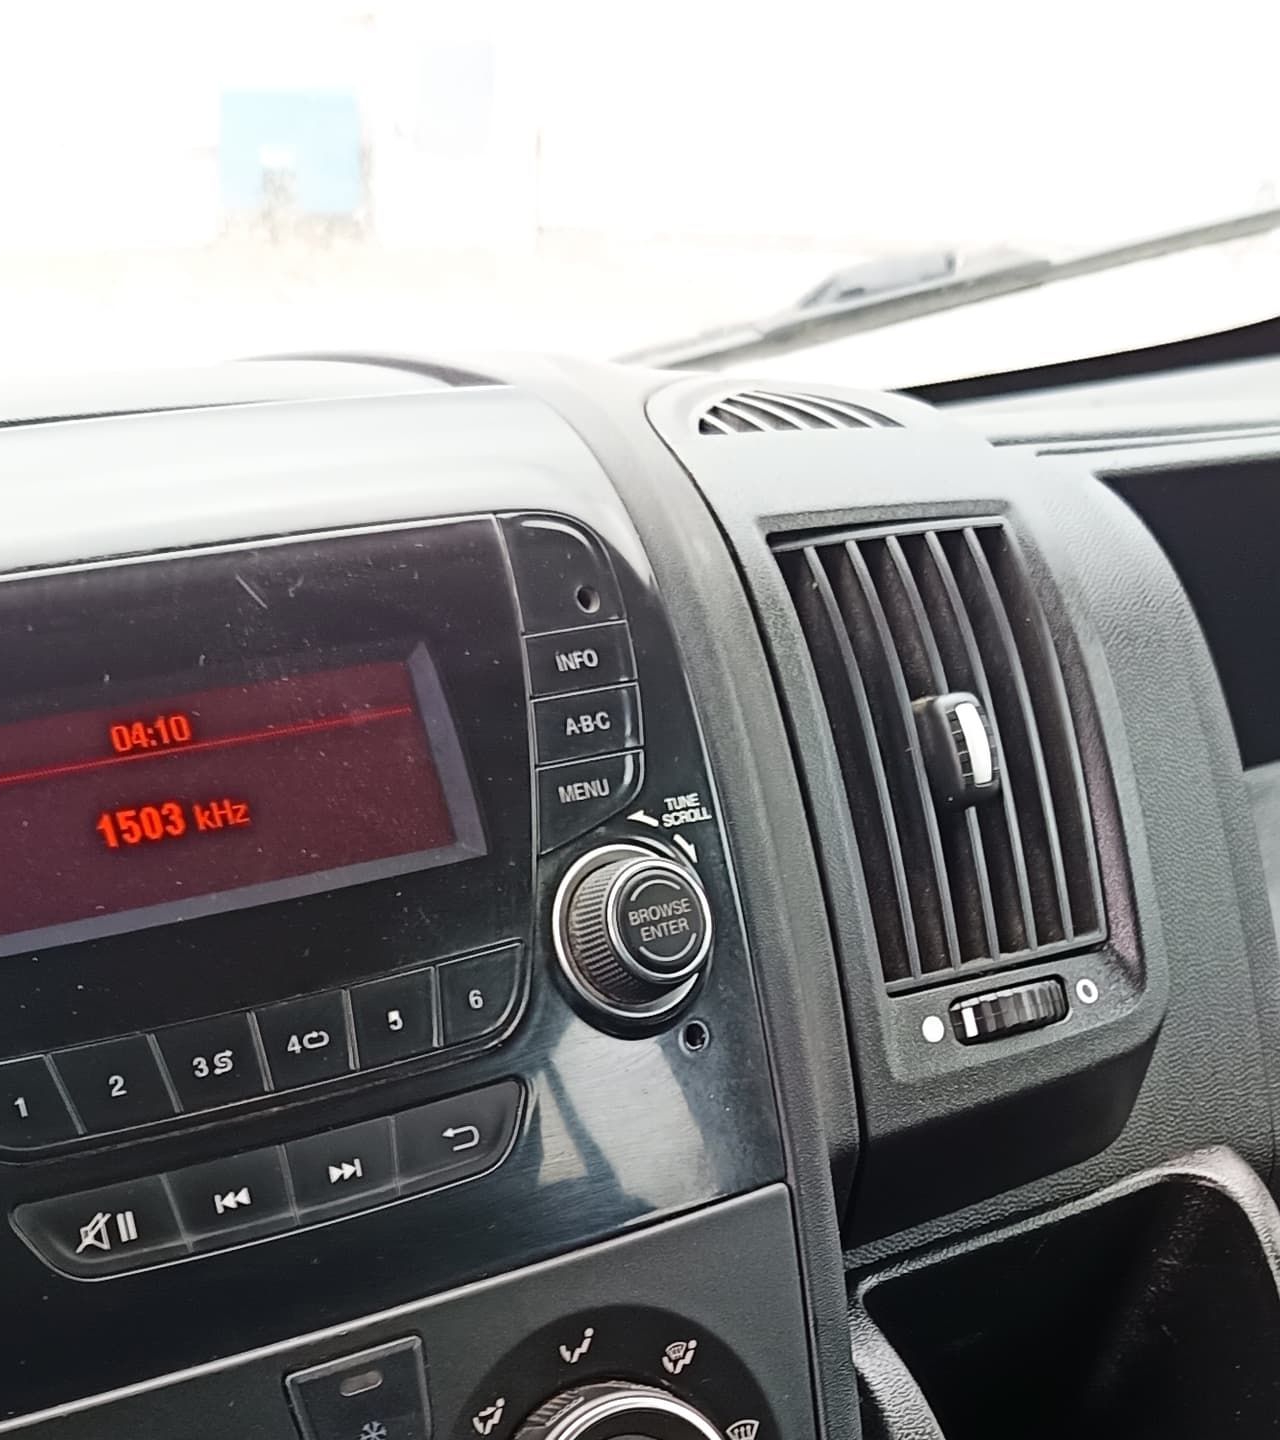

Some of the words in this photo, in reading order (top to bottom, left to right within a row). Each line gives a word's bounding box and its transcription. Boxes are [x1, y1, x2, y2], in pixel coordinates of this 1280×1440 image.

[555, 647, 598, 673] INFO
[110, 714, 193, 754] 04:10
[558, 778, 610, 804] MENU
[663, 792, 700, 811] TUNE
[97, 803, 186, 849] 1503
[194, 798, 250, 833] kHz
[661, 805, 712, 829] SCROLL
[628, 898, 692, 928] BROWSE
[639, 917, 690, 944] ENTER
[468, 988, 484, 1011] 6
[387, 1009, 404, 1032] 5
[108, 1074, 128, 1098] 2
[13, 1096, 29, 1119] 1
